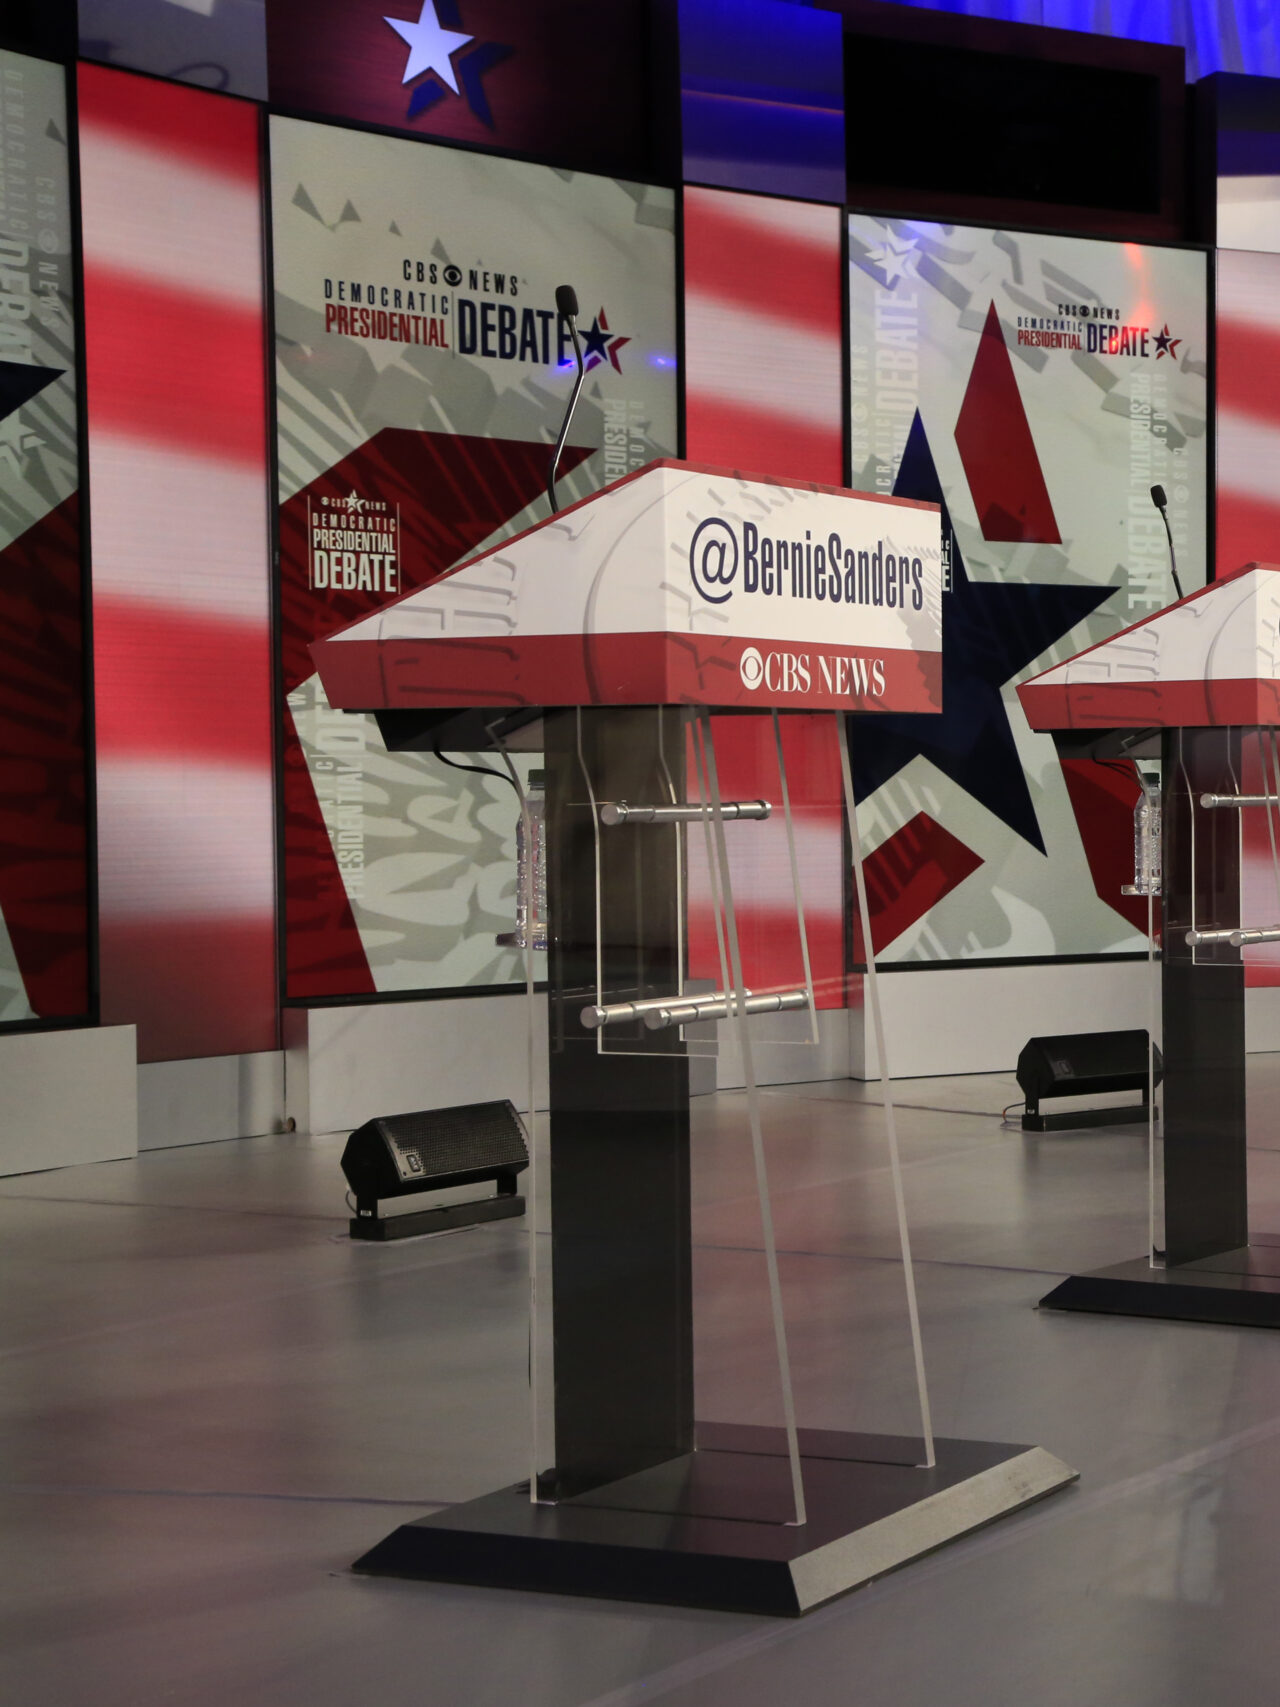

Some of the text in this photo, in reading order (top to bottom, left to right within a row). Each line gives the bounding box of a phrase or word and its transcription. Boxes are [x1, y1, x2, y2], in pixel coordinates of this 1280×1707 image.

[403, 259, 518, 296] CBS NEWS
[324, 278, 449, 315] DEMOCRATIC
[1058, 303, 1120, 321] CBS NEWS
[325, 303, 449, 348] PRESIDENTIAL
[458, 298, 575, 367] DEBATE
[1017, 316, 1083, 333] DEMOCRATIC
[1017, 329, 1082, 351] PRESIDENTIAL
[1087, 322, 1149, 358] DEBATE
[875, 290, 919, 411] DEBATE
[312, 512, 396, 532] DEMOCRATIC
[365, 501, 387, 511] NEWS
[313, 528, 396, 553] PRESIDENTIAL
[314, 549, 397, 592] DEBATE
[689, 517, 923, 611] @BernieSanders
[764, 651, 886, 696] CBS NEWS
